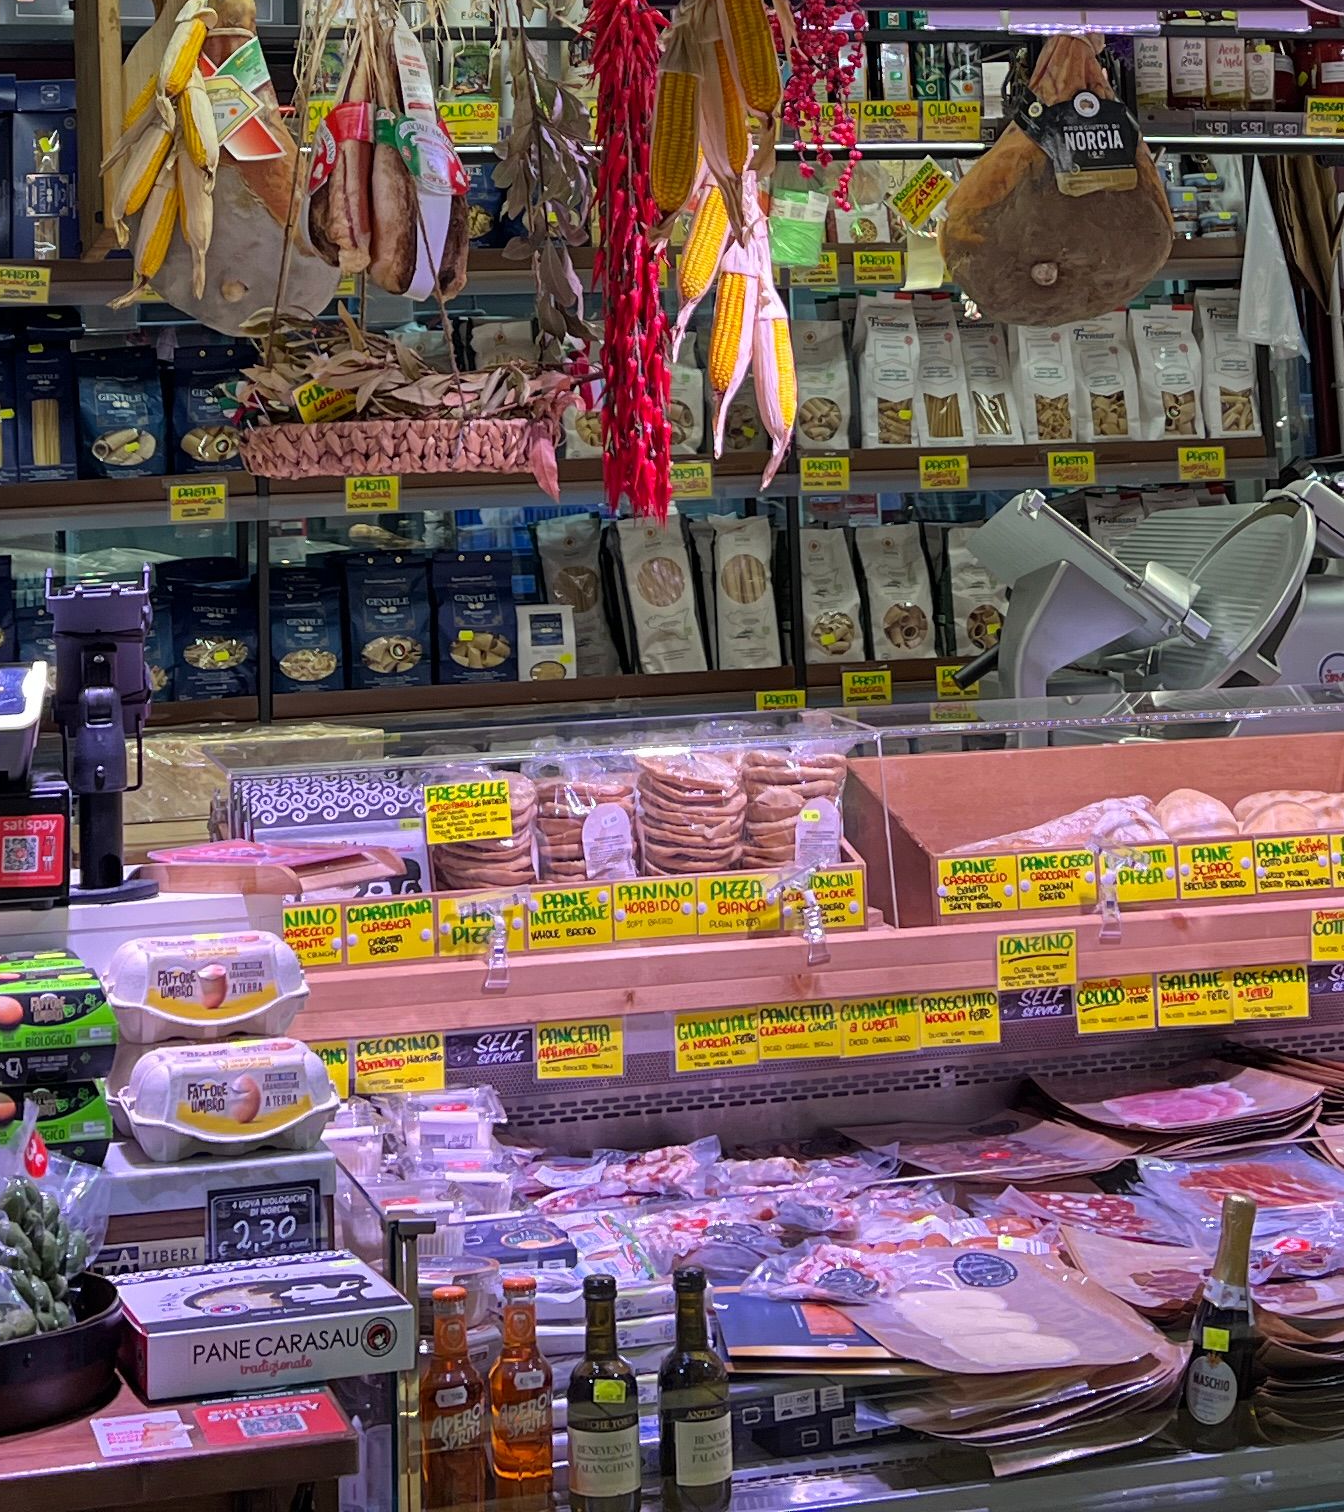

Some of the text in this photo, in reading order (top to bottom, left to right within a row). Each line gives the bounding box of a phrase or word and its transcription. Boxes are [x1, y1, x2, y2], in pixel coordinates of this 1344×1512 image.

[864, 104, 893, 118] OLIO
[928, 103, 957, 118] OLIO
[1064, 129, 1124, 152] NORCIA
[0, 268, 40, 280] PASTA
[98, 392, 142, 403] GENTILE
[807, 459, 842, 471] PASTA
[925, 458, 961, 470] PASTA
[177, 486, 217, 497] PASTA
[366, 595, 410, 606] GENTILE
[455, 592, 496, 603] GENTILE
[426, 781, 507, 803] FRESELLE
[3, 819, 57, 833] satispay
[1192, 844, 1233, 862] PANE
[1257, 841, 1295, 858] PANE
[951, 859, 996, 875] PANE
[1021, 855, 1058, 872] PANE
[1193, 862, 1233, 874] SCIAPO
[944, 873, 1007, 886] CASARECCIO
[1120, 868, 1163, 885] PIZZA
[618, 882, 694, 900] PANINO
[710, 880, 764, 901] PIZZA
[542, 891, 590, 909] PANE
[625, 899, 680, 914] MORBIDO
[718, 899, 767, 914] BIANCA
[346, 898, 432, 923] CIABATTINA
[531, 904, 609, 923] INTEGRALE
[361, 919, 411, 933] CLASSICA
[1000, 934, 1073, 956] LONZINO
[158, 969, 196, 988] FATTORE
[1160, 971, 1224, 991] SALAME
[1232, 966, 1307, 988] BRESAOLA
[921, 991, 998, 1011] PROSCIUTTO
[1077, 987, 1125, 1006] CRUDO
[760, 1002, 835, 1025] PANCETTA
[840, 996, 919, 1022] GUANCIALE
[925, 1010, 966, 1025] NORCIA
[539, 1023, 611, 1045] PANCETTA
[677, 1012, 757, 1040] GUANCIALE
[25, 1033, 72, 1048] BIOLOGICO
[357, 1033, 440, 1056] PECORINO
[473, 1031, 524, 1054] SELF
[693, 1036, 731, 1050] NORCIA
[356, 1056, 406, 1073] Romano
[477, 1050, 524, 1066] SERVICE
[187, 1083, 229, 1100] FATTORE
[233, 1215, 297, 1253] 2,30
[142, 1246, 198, 1264] TIBERI
[192, 1326, 360, 1365] PANE CARASAU
[240, 1354, 313, 1377] tradizionale
[1193, 1371, 1231, 1392] MASCHIO
